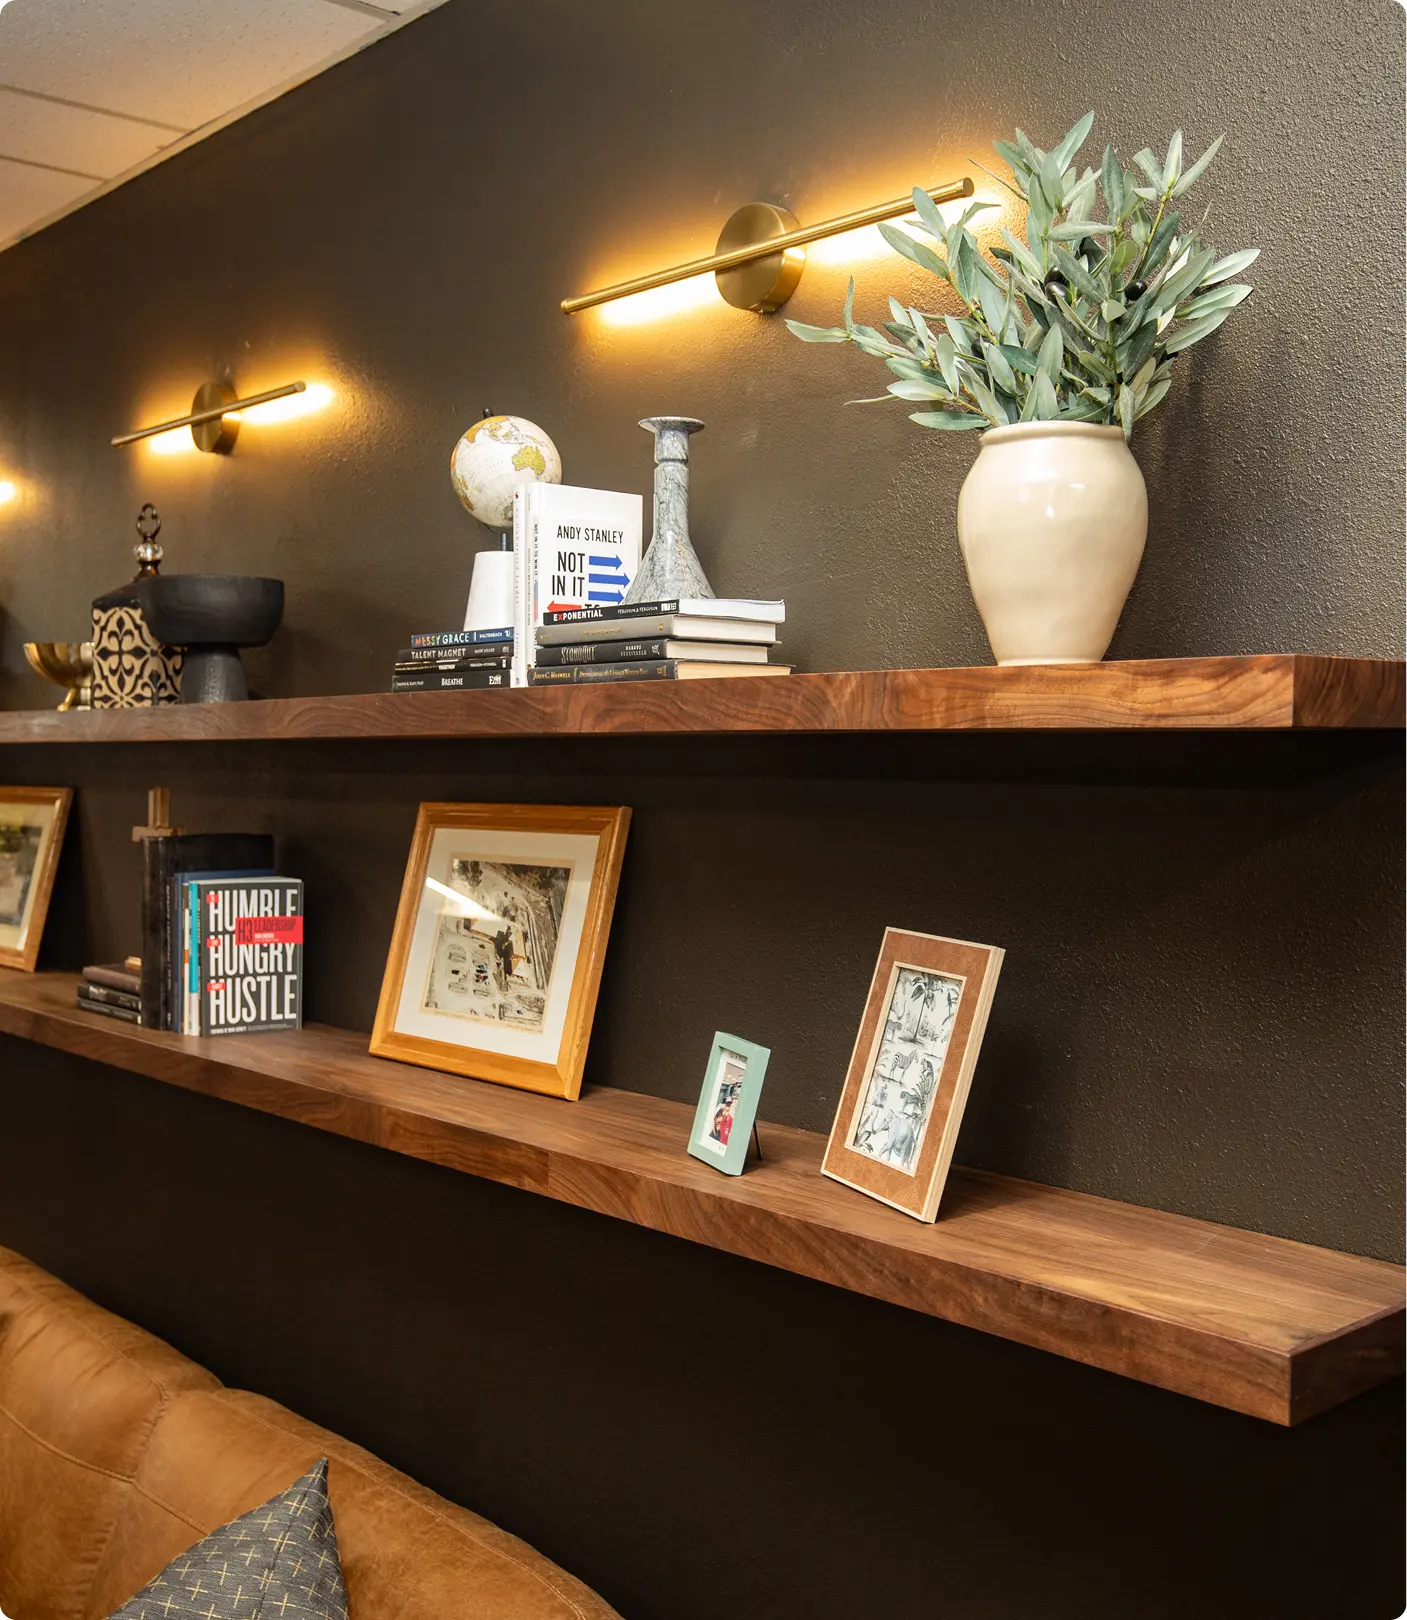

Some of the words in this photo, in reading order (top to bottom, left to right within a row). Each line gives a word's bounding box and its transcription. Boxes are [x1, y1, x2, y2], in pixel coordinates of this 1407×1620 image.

[557, 525, 581, 540] ANDY
[584, 527, 624, 544] STANLEY
[557, 551, 586, 573] NOT
[552, 574, 566, 596] IN
[572, 576, 585, 597] IT
[553, 609, 604, 622] EXPONENTIAL
[415, 635, 440, 647] MESSY
[442, 633, 469, 645] GRACE
[411, 650, 436, 660] TALENT
[437, 648, 466, 658] MAGNET
[441, 677, 464, 686] BREATHE
[209, 888, 298, 933] HUMBLE
[238, 920, 252, 942] H3
[254, 918, 296, 932] LEADERSHIP
[209, 934, 296, 977] HUNGRY
[210, 974, 298, 1026] HUSTLE
